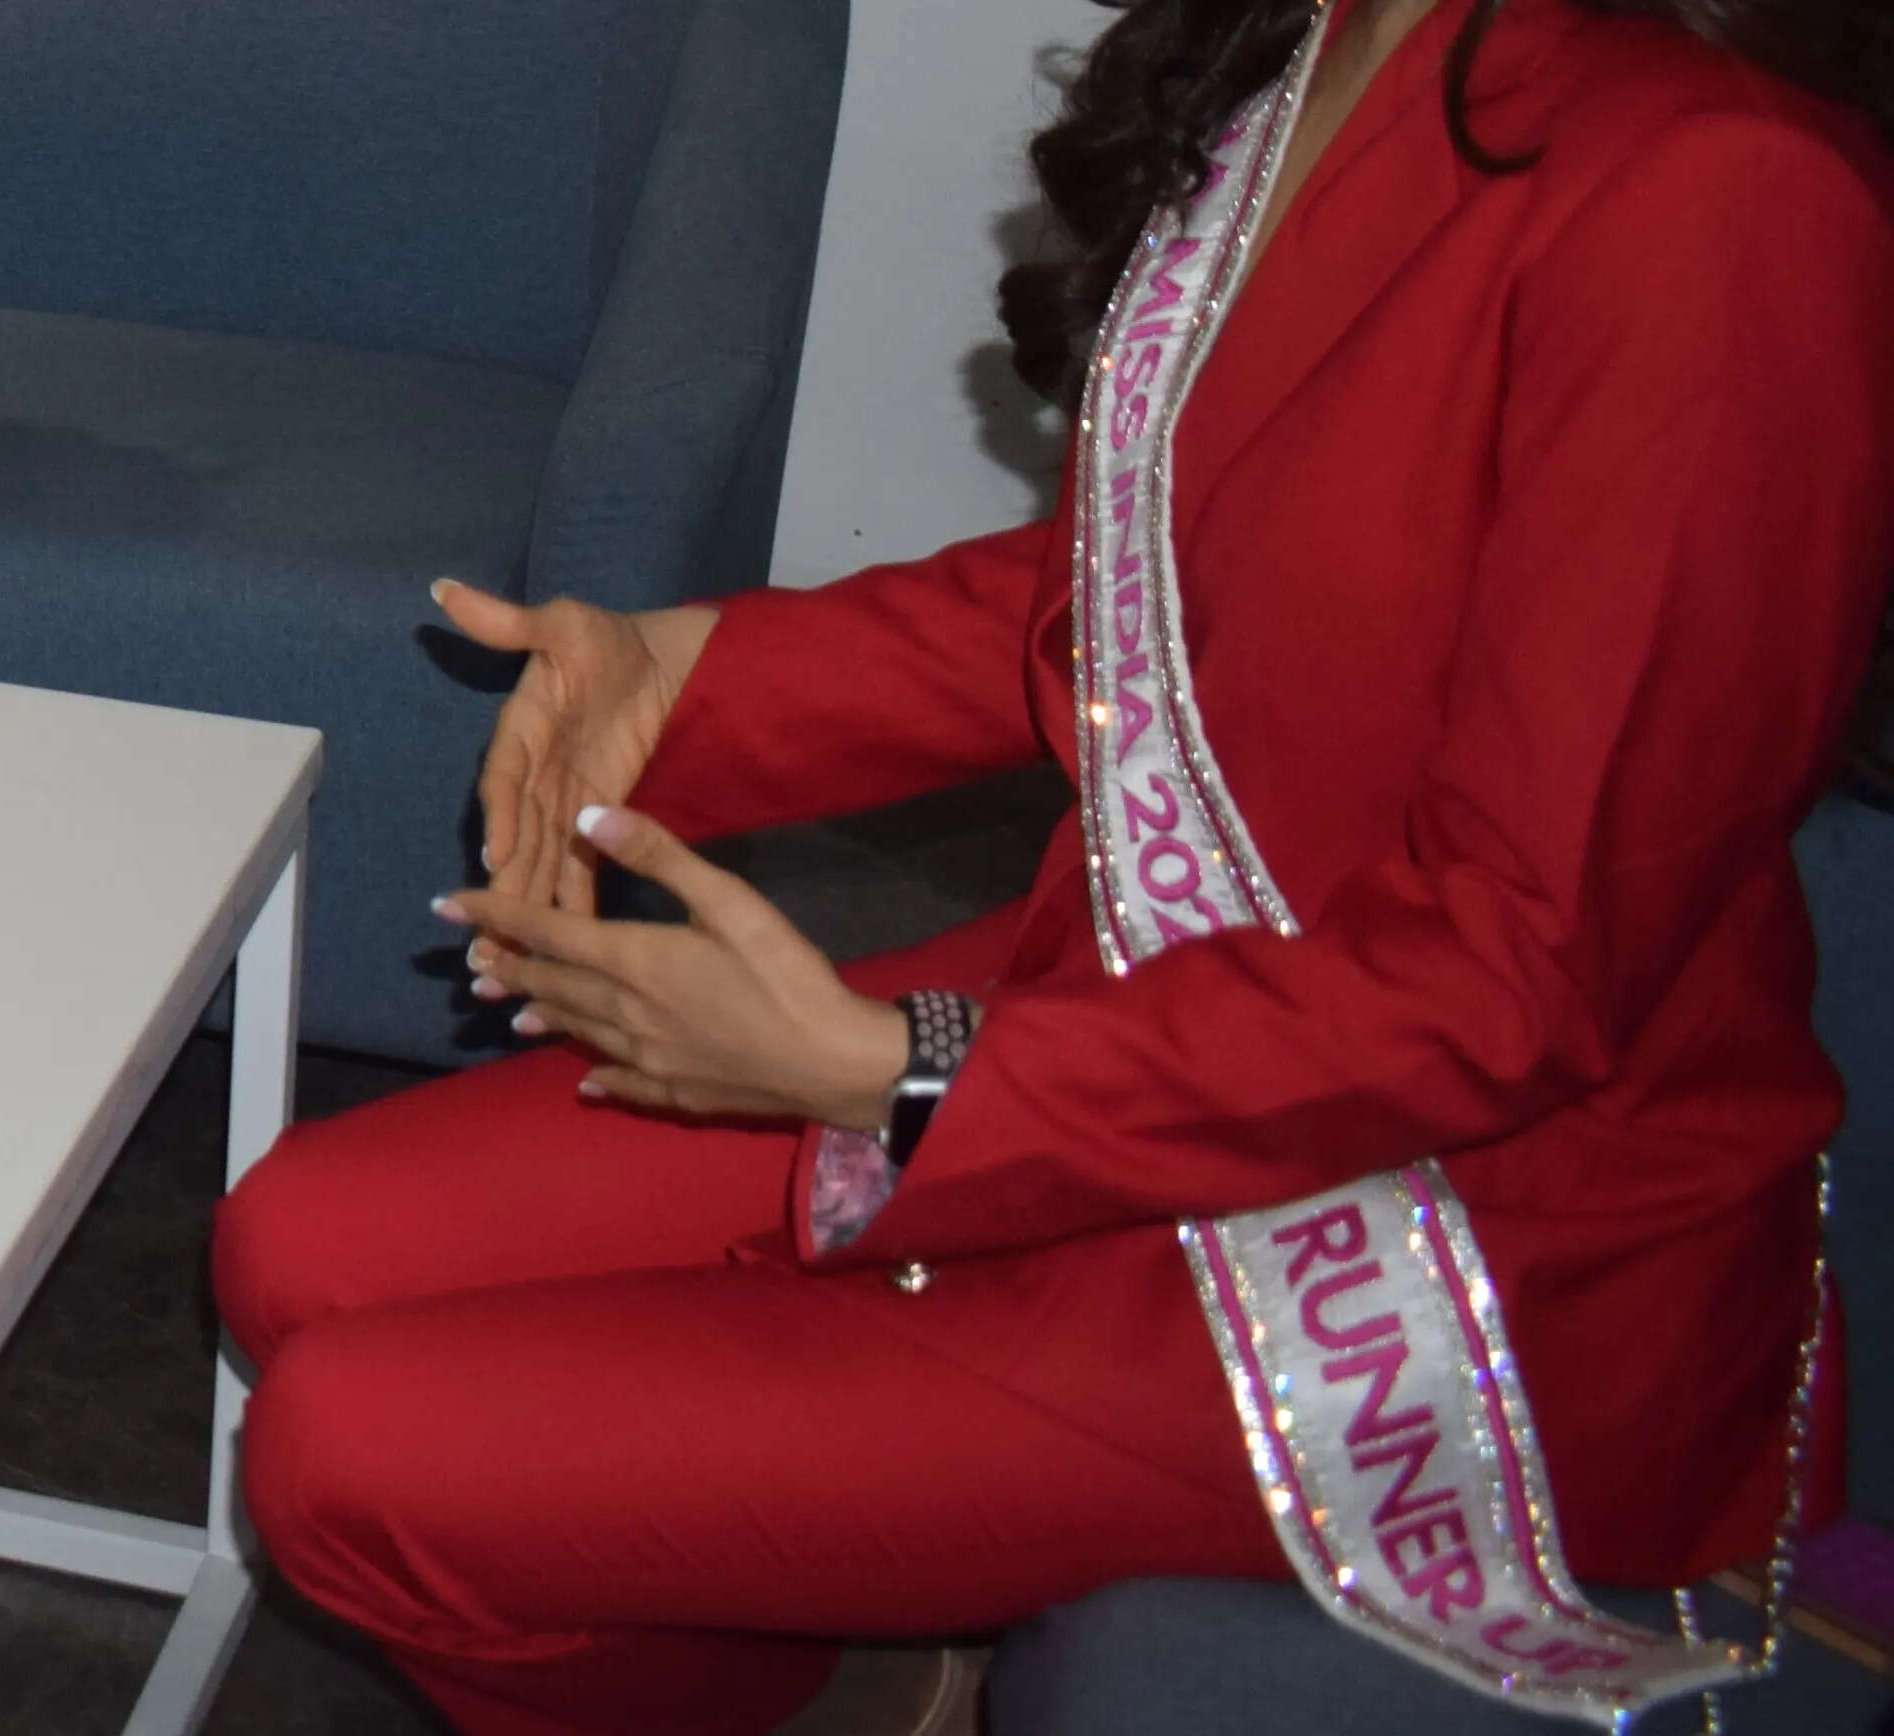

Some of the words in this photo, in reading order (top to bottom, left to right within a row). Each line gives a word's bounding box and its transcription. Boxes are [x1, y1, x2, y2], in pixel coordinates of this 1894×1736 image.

[1111, 237, 1201, 451] MISS
[1110, 469, 1153, 767] INDIA
[1271, 1202, 1487, 1625] RUNNER
